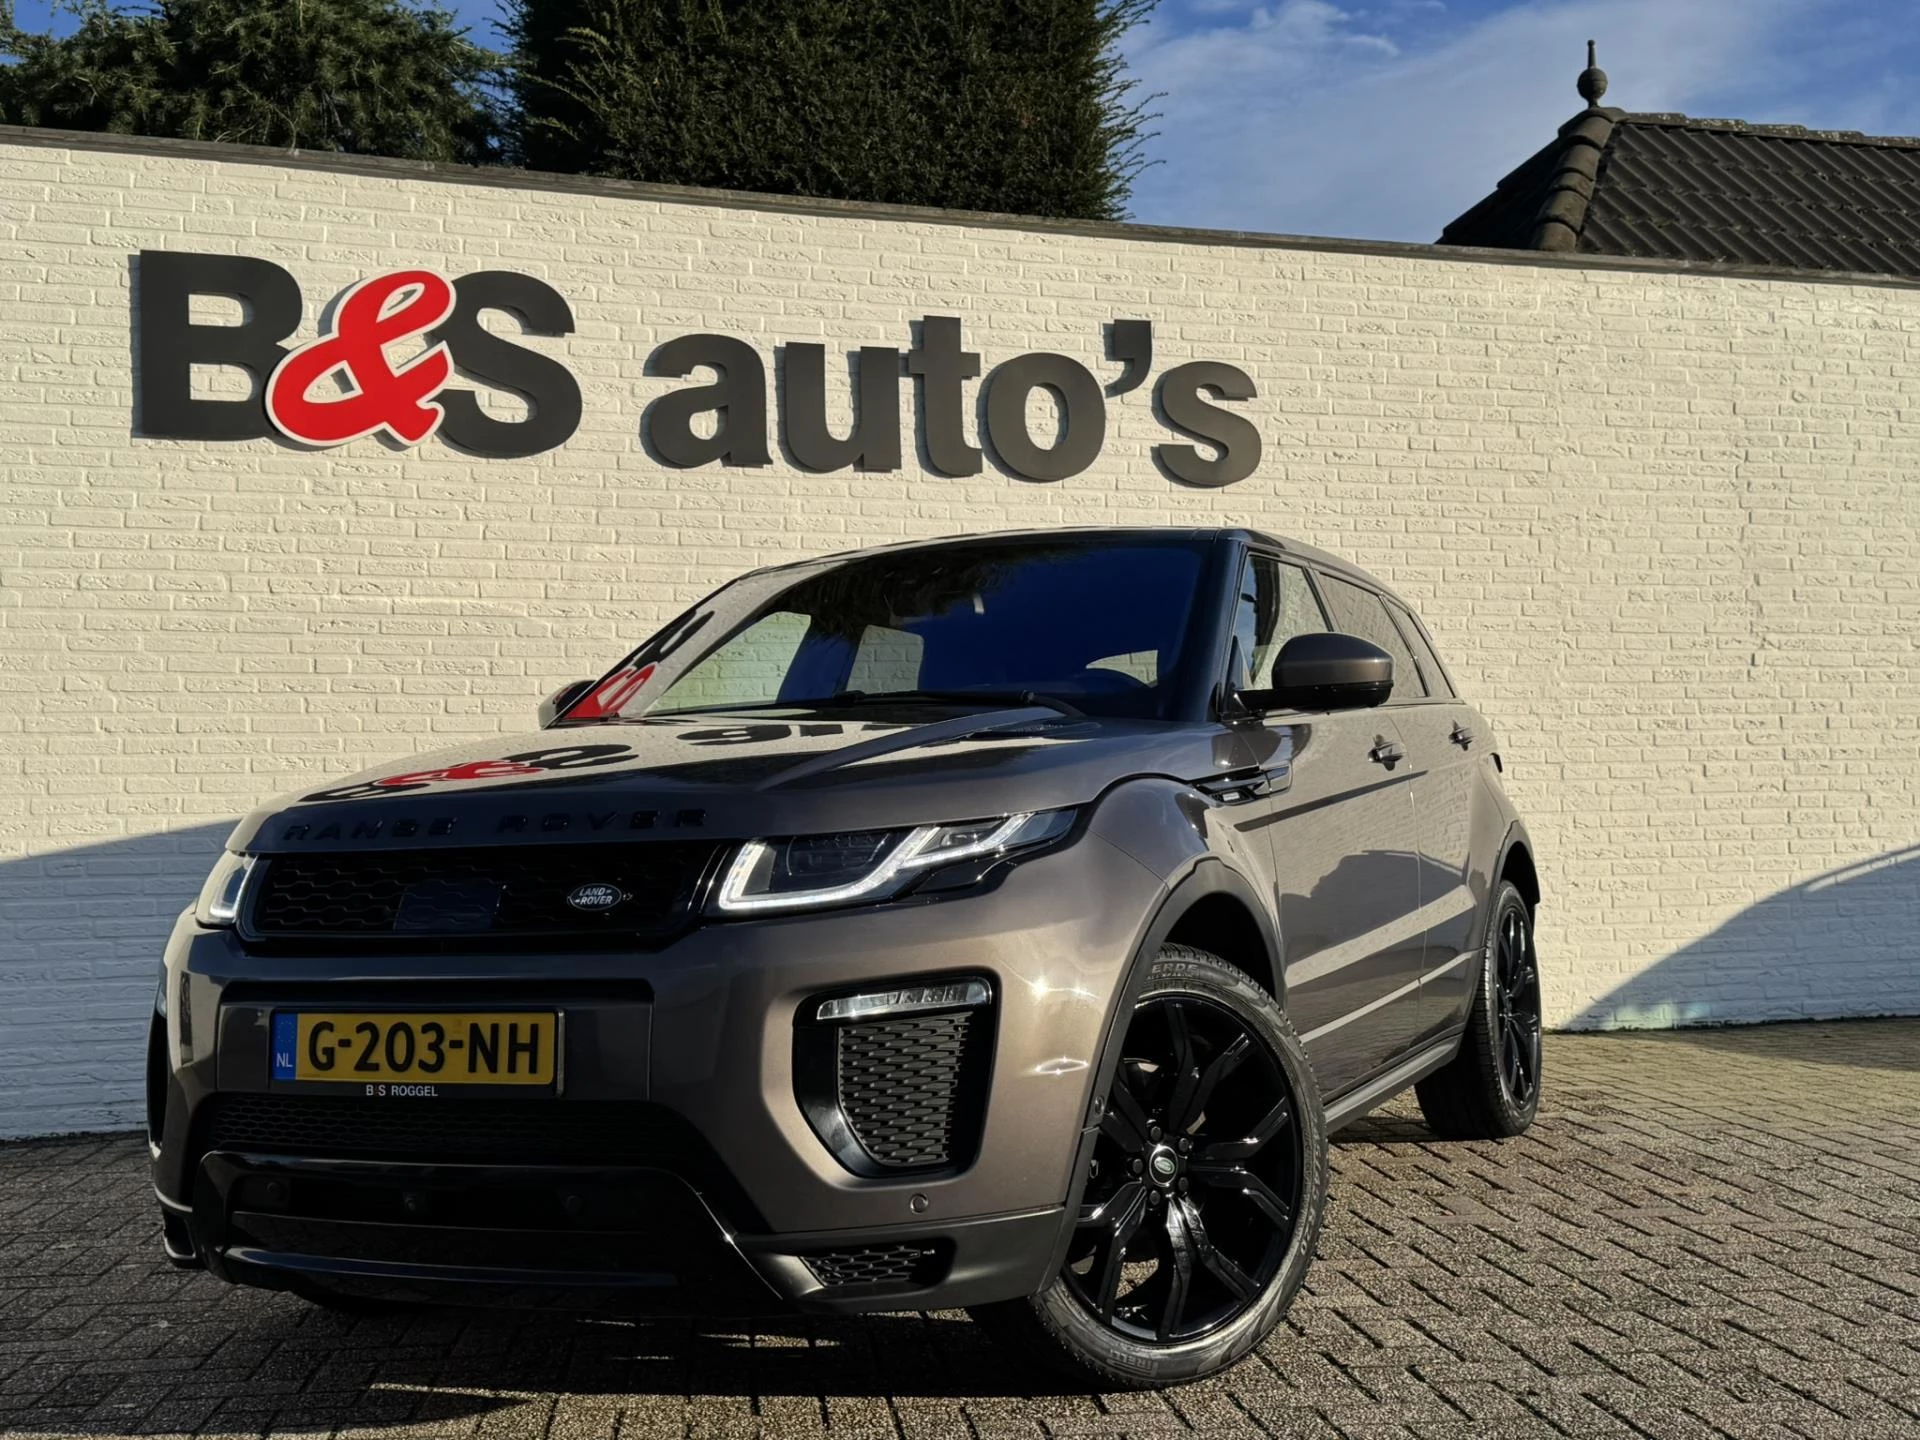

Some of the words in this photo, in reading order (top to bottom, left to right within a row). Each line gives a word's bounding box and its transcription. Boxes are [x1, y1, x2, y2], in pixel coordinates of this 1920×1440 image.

[139, 249, 583, 460] B&S
[642, 314, 1263, 488] auto's
[285, 816, 459, 841] RANGE
[494, 808, 708, 833] ROVER
[275, 1052, 294, 1068] NL
[307, 1020, 540, 1075] G-203-NH
[391, 1085, 439, 1097] ROGGEL
